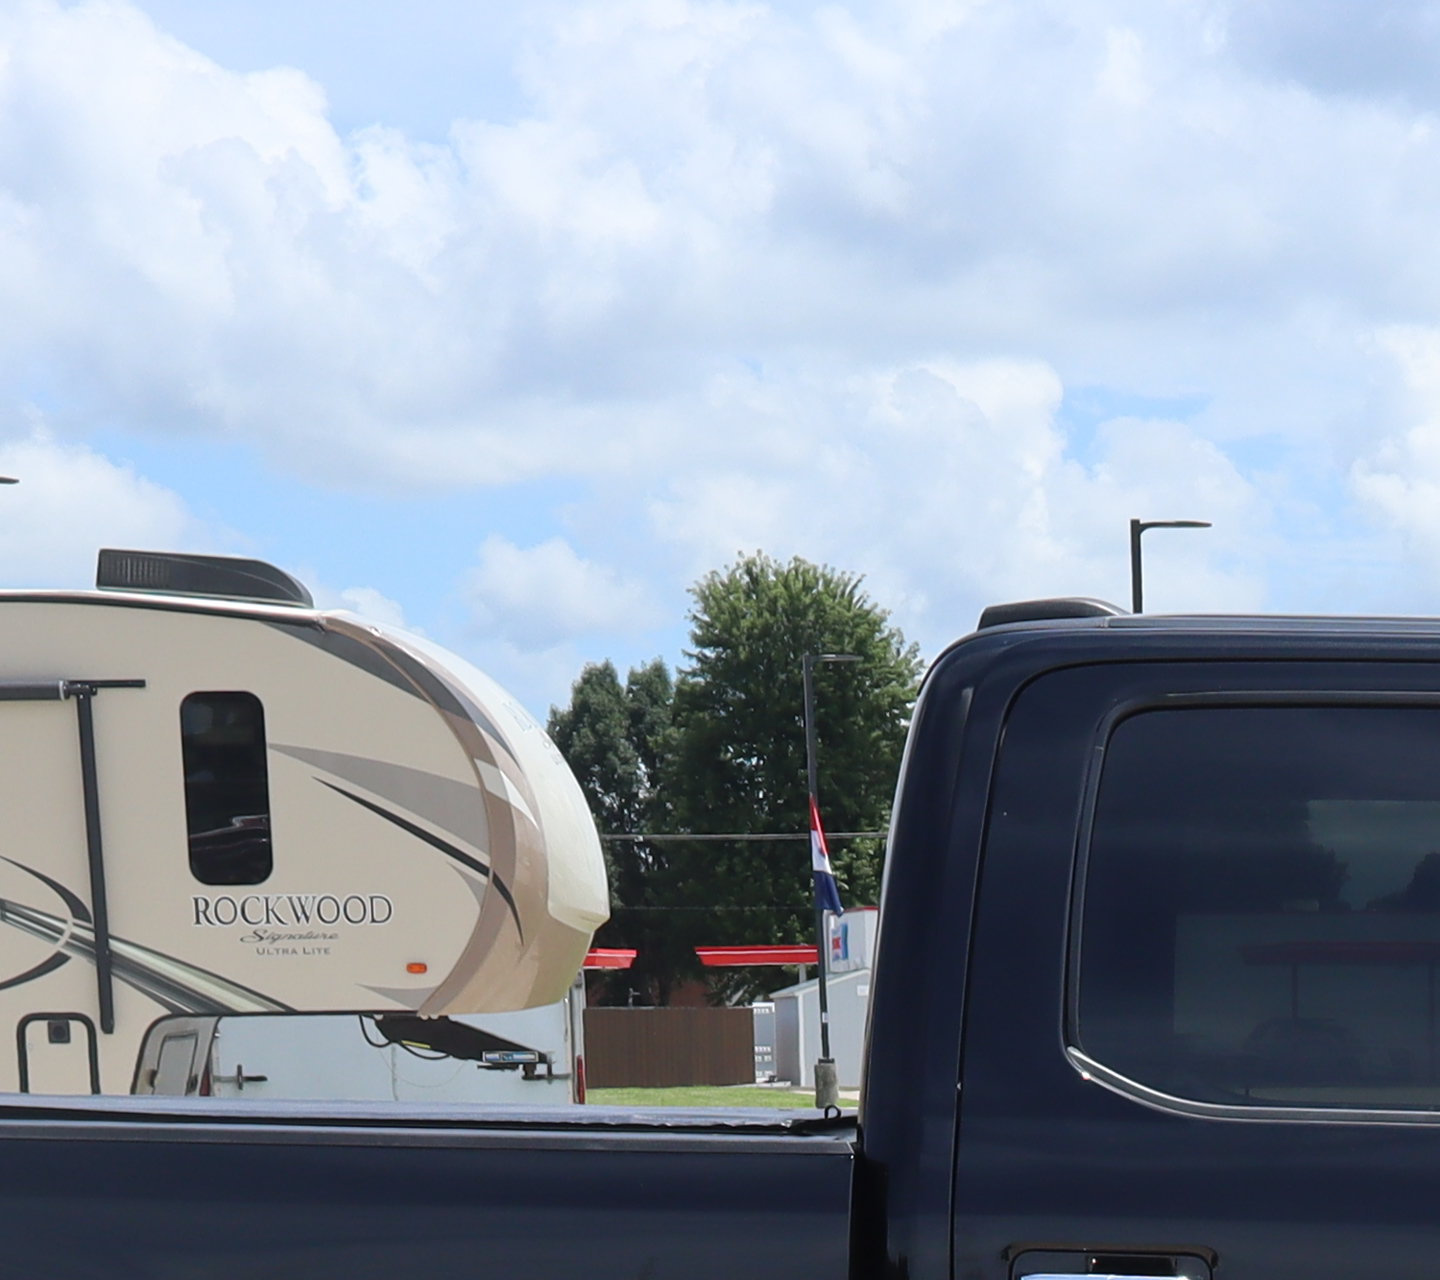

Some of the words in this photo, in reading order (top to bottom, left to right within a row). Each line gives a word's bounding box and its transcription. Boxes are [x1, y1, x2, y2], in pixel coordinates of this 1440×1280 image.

[192, 894, 393, 927] ROCKWOOD
[240, 929, 339, 944] Signature
[302, 947, 331, 955] LITE
